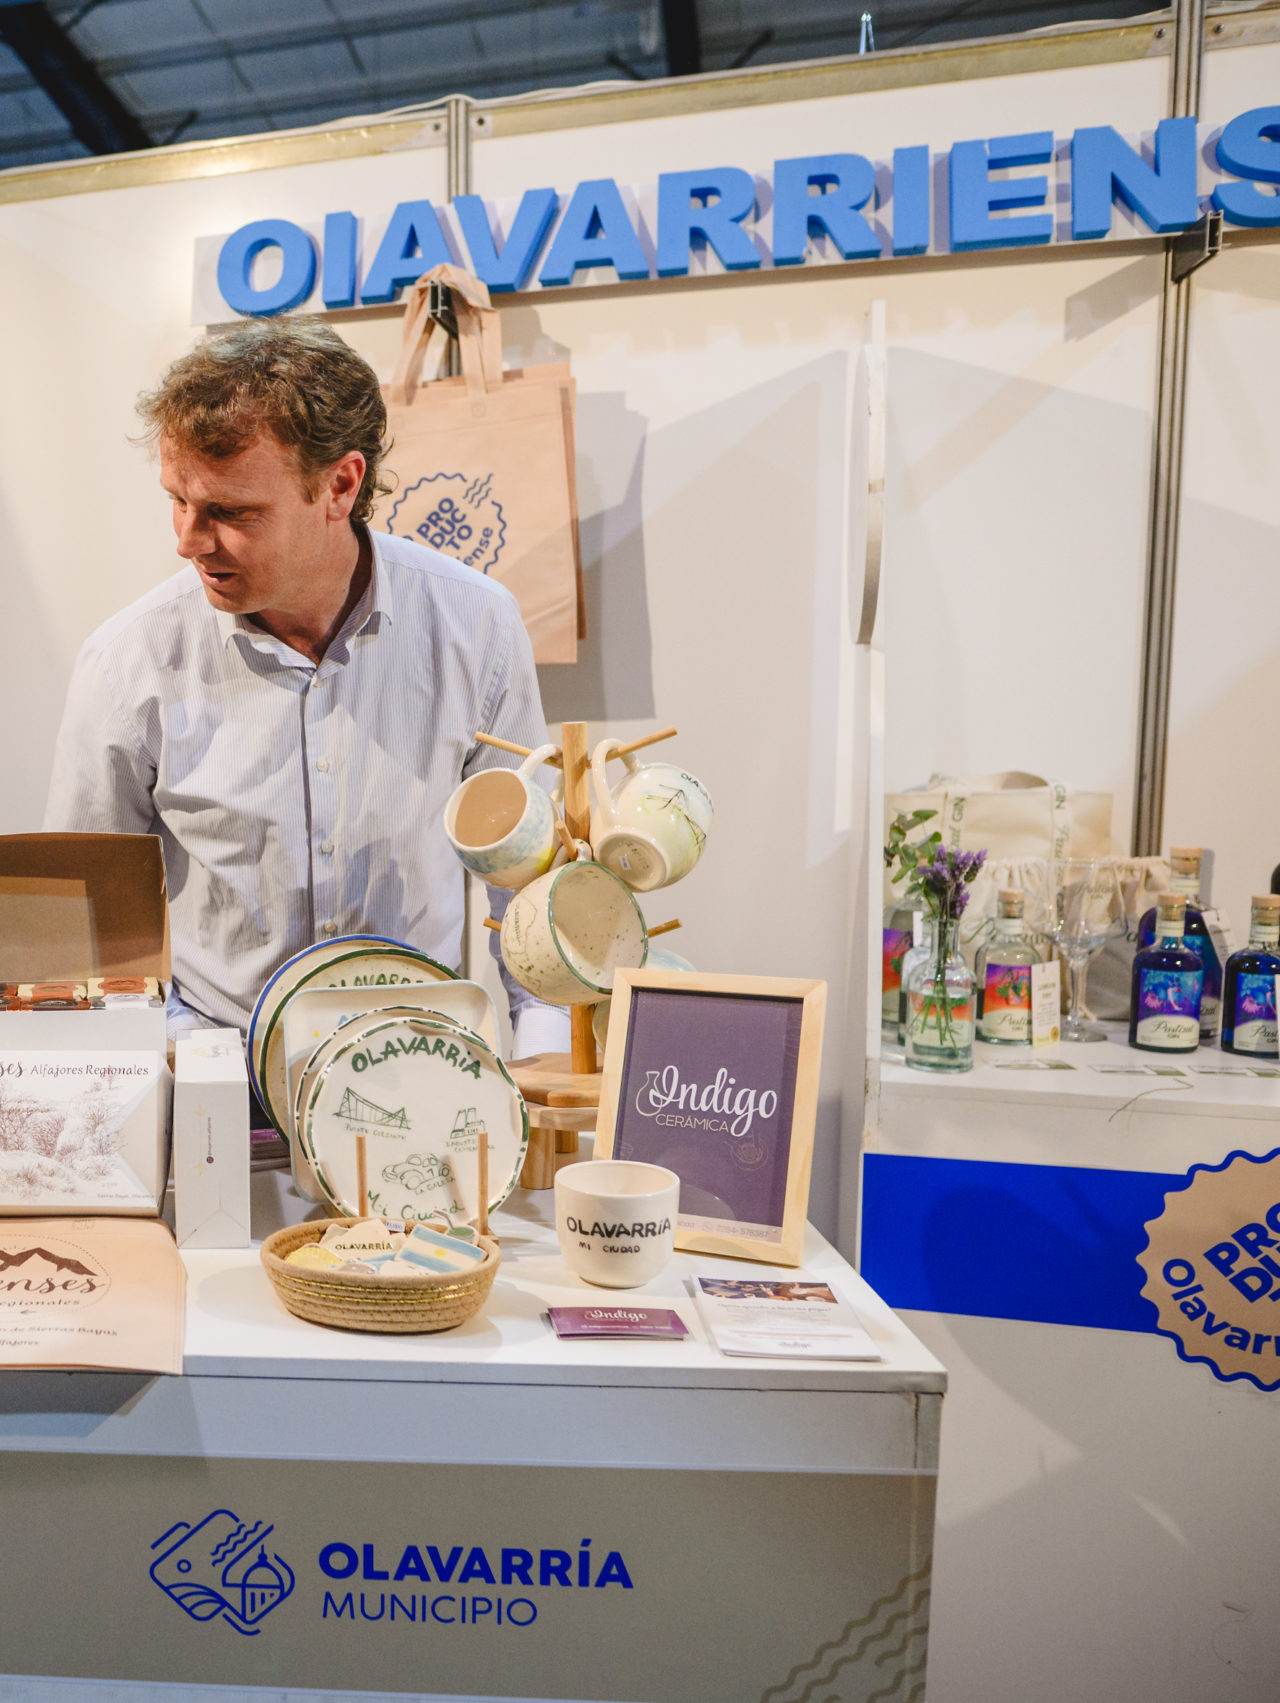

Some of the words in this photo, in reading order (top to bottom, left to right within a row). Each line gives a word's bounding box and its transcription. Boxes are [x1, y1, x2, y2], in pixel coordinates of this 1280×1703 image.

[416, 497, 455, 539] PRO
[428, 507, 467, 549] DUC
[445, 524, 473, 551] TO
[30, 1063, 83, 1078] Alfajores
[85, 1064, 149, 1078] Regionales
[649, 1065, 778, 1137] Indigo
[602, 1245, 641, 1254] CIUDAD
[590, 1309, 648, 1323] Indigo
[318, 1537, 634, 1589] OLAVARRÍA
[322, 1590, 538, 1627] MUNICIPIO
